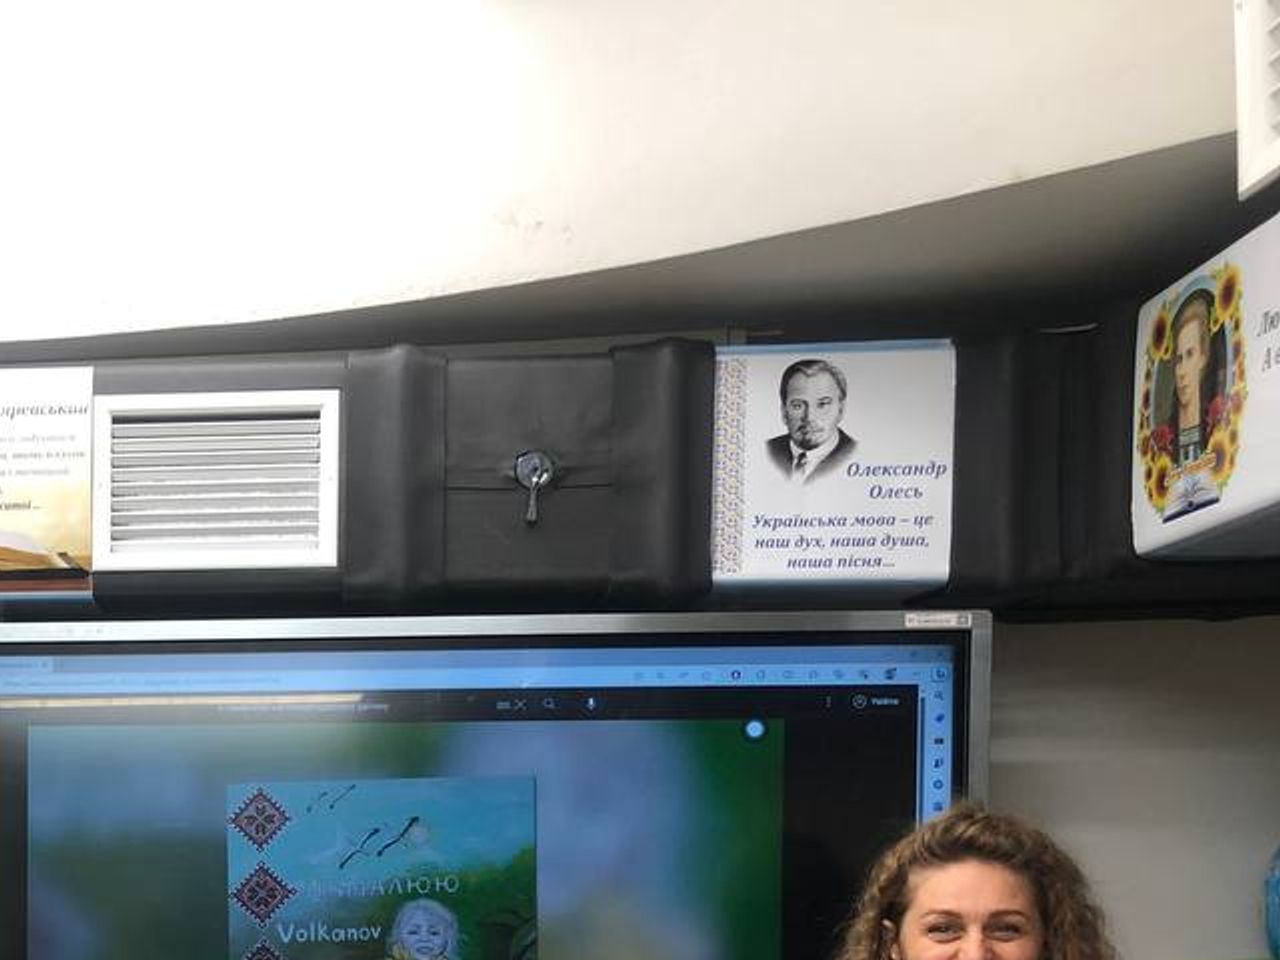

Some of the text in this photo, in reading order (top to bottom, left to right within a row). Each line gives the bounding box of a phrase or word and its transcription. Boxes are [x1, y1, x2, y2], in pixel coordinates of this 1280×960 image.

[846, 459, 948, 480] Олександр
[869, 484, 923, 499] Олесь
[752, 515, 847, 532] Українська
[851, 515, 896, 527] мова
[913, 515, 934, 529] це
[754, 533, 929, 551] наш дух, наша душа,
[787, 554, 896, 569] наша пісня...
[277, 922, 383, 944] Volkanov
